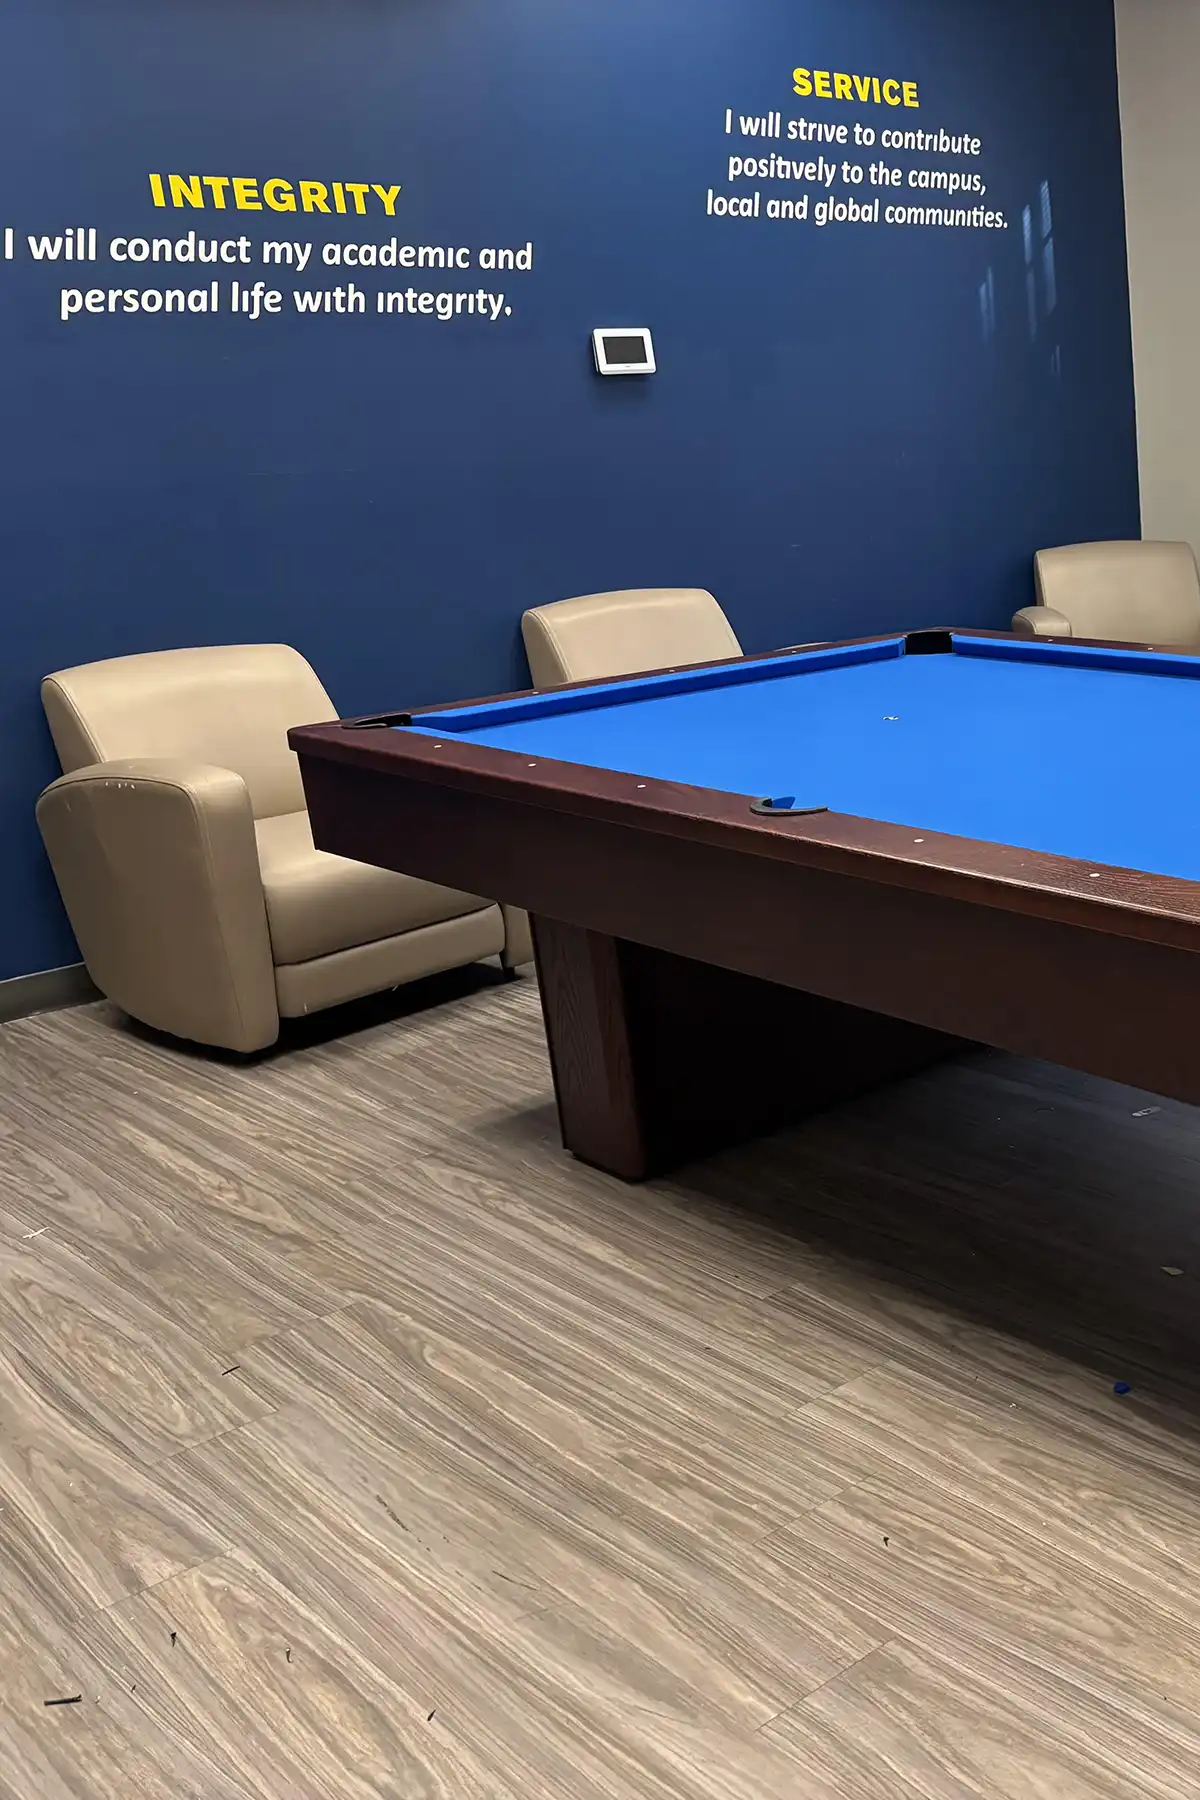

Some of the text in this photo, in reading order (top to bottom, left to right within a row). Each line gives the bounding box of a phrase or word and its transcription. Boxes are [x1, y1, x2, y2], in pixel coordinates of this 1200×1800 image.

[792, 67, 920, 108] SERVICE
[725, 108, 981, 156] I will strive to contribute
[148, 173, 402, 217] INTEGRITY
[728, 153, 987, 196] positively to the campus,
[706, 188, 1009, 229] local and global communities.
[4, 227, 533, 272] I will conduct my academic and
[60, 280, 512, 321] personal life with integrity.
